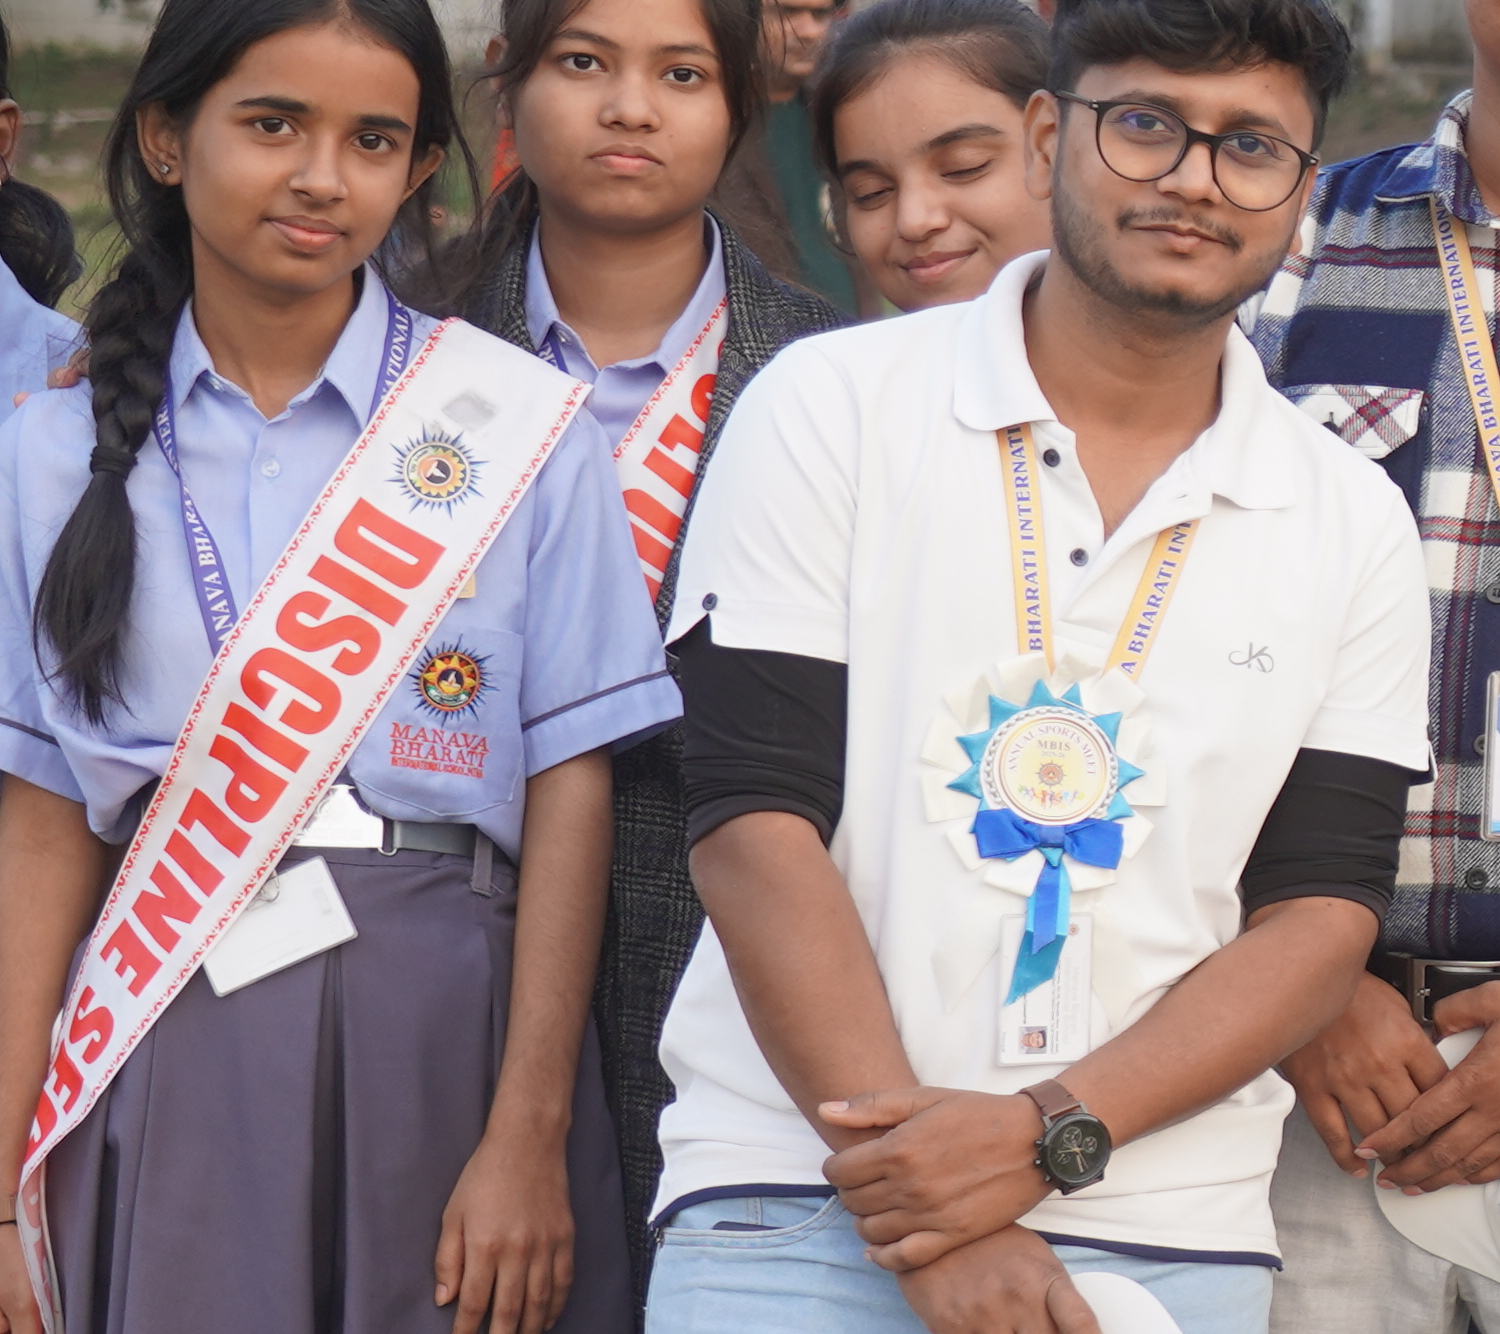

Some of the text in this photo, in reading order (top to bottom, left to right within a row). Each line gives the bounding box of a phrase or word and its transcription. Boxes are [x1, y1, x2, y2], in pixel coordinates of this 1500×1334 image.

[1436, 202, 1478, 335] INTERNATIONA
[1463, 339, 1500, 430] BHARATI
[1006, 425, 1044, 652] BHARATI INTERNATI
[1128, 559, 1178, 654] BHARATI
[101, 496, 446, 1000] DISCIPLINE
[389, 722, 490, 753] MANAVA
[389, 739, 488, 768] BHARATI
[1038, 725, 1082, 744] SPORTS
[1038, 739, 1072, 752] MBIS
